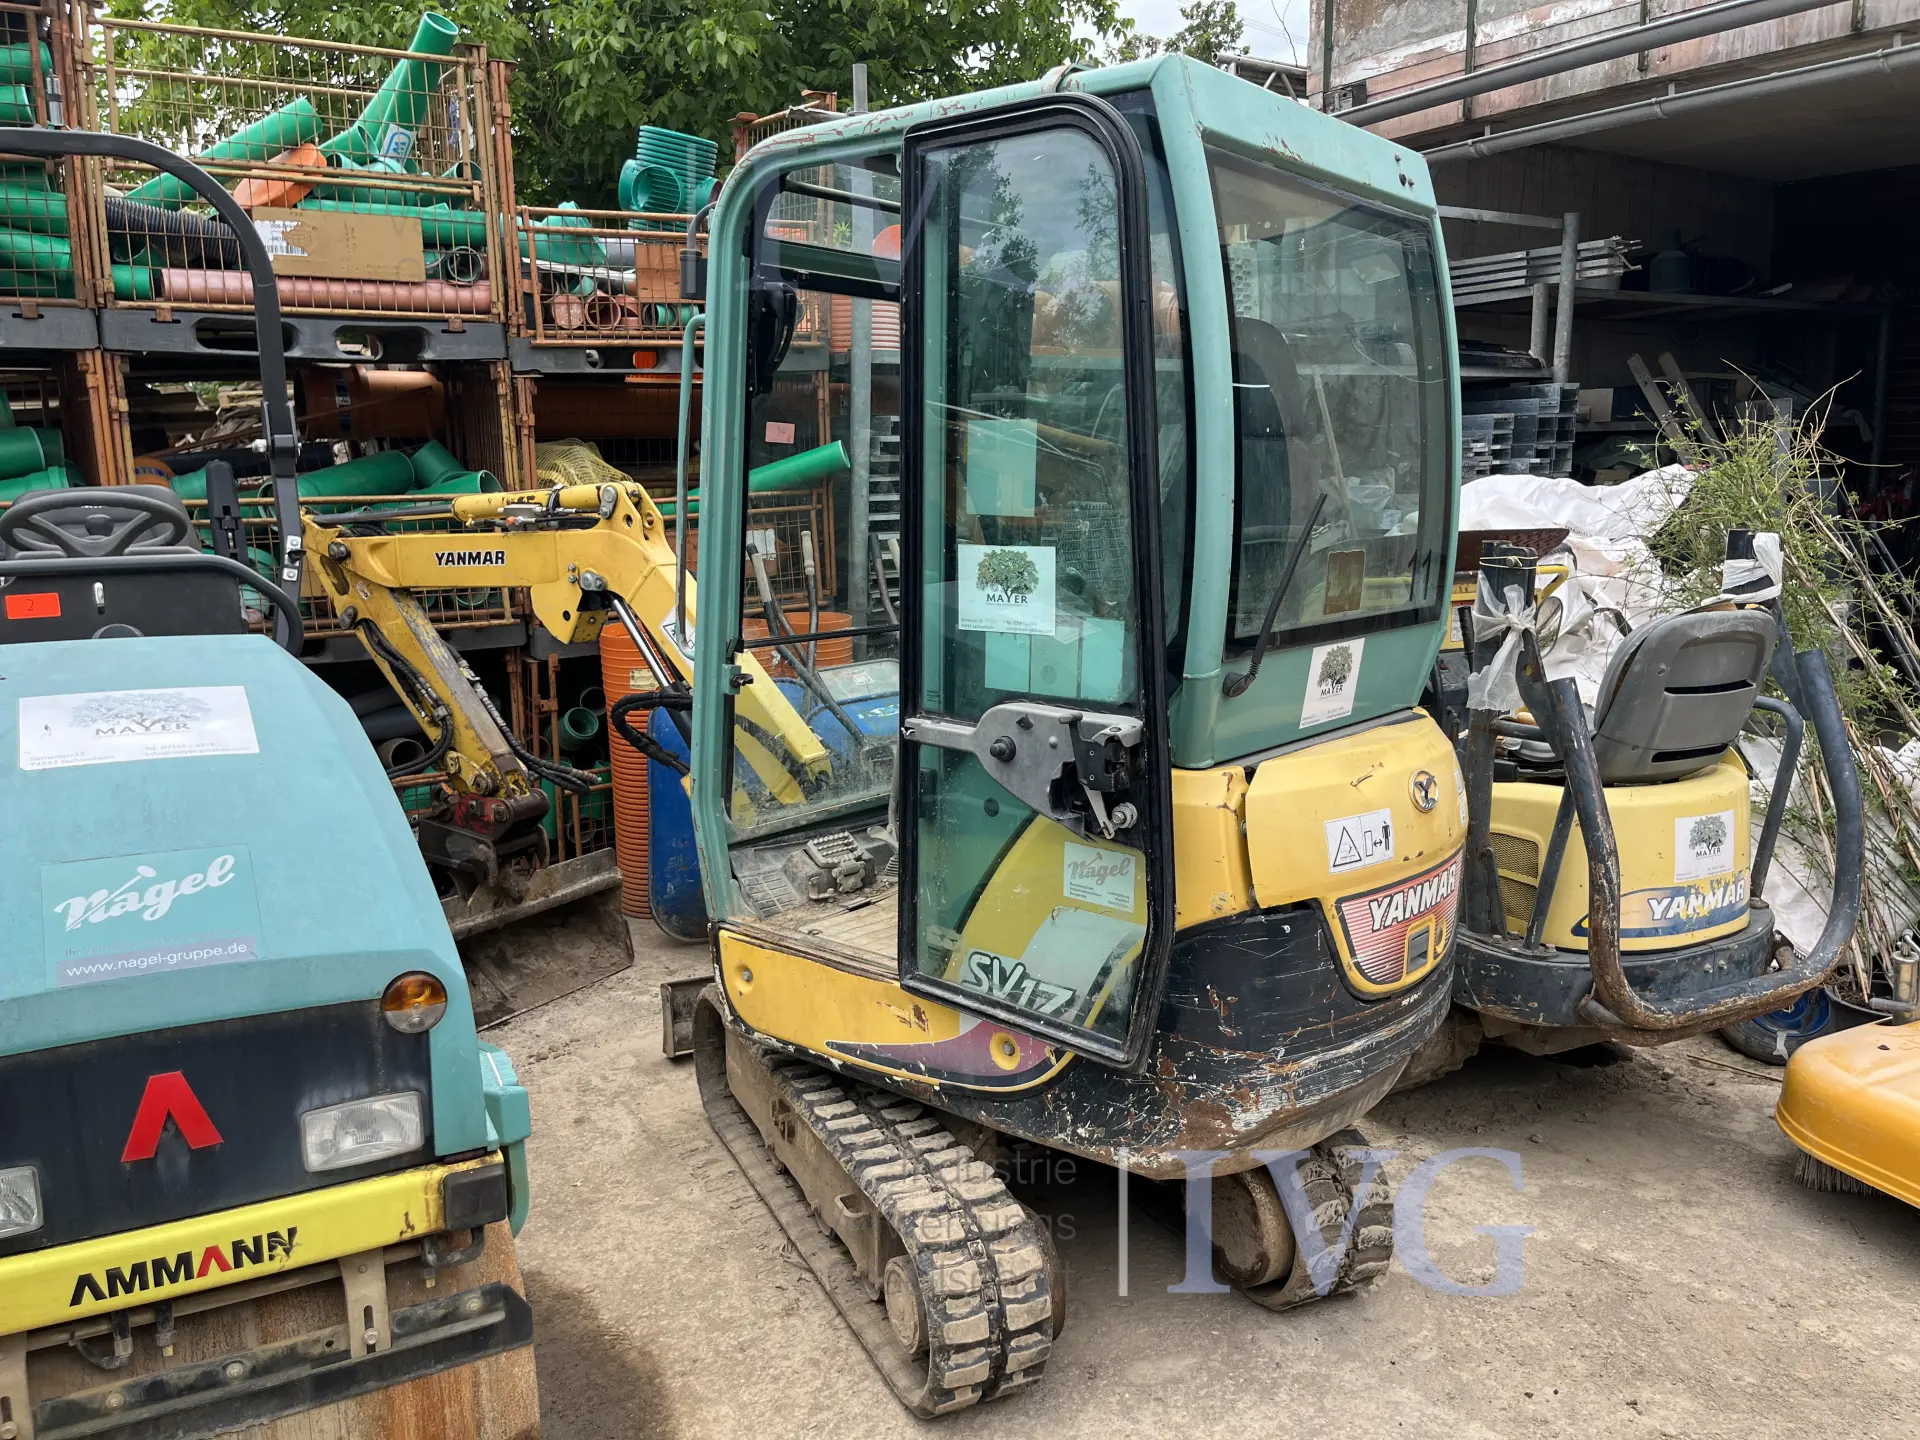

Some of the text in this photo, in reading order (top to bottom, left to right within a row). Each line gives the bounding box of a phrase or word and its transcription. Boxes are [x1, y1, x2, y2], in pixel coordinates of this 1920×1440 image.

[435, 550, 505, 567] YANMAR
[986, 592, 1028, 604] MAYER
[1320, 684, 1343, 696] MAYER
[95, 721, 192, 736] MAYER
[1068, 852, 1130, 886] Nagel
[1695, 846, 1721, 858] MAYER
[54, 854, 235, 932] Nagel
[1369, 862, 1456, 932] YANMAR
[1648, 879, 1745, 921] YANMAR
[66, 943, 247, 977] www.nagel-gruppe.de
[961, 951, 1077, 1015] SV17
[69, 1226, 298, 1307] AMMANN
